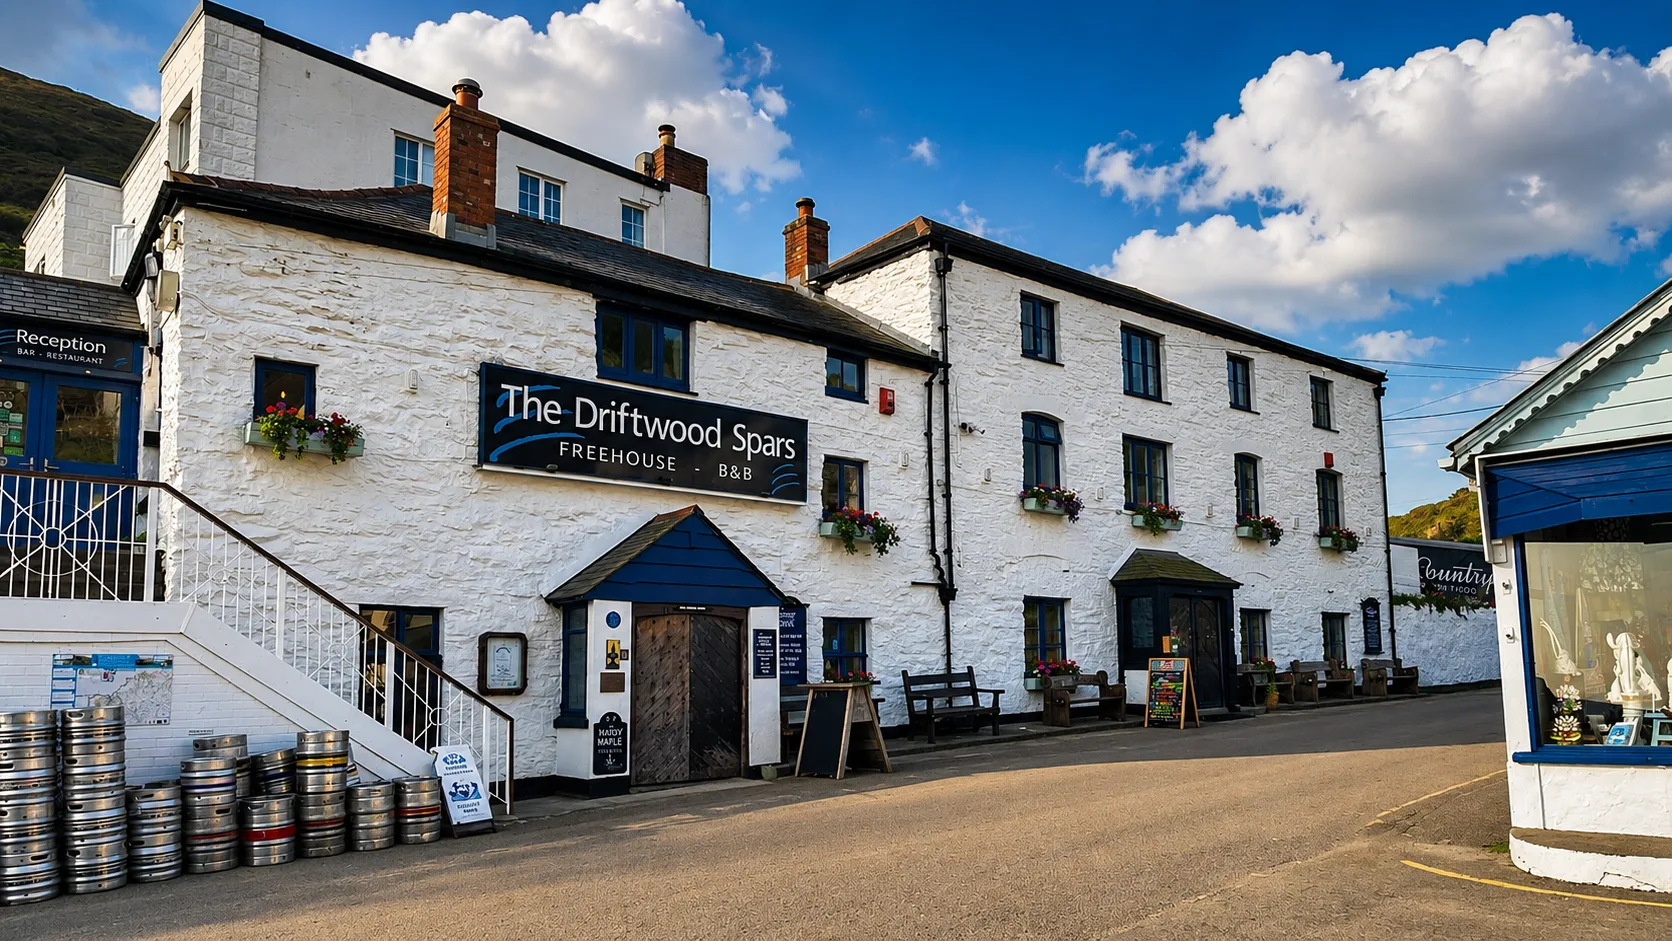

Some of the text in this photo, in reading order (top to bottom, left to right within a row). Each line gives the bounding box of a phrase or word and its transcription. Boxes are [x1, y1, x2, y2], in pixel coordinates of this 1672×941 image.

[16, 329, 107, 354] Reception
[17, 348, 36, 356] BAR
[46, 352, 104, 365] RESTAURANT
[500, 383, 796, 461] The Driftwood Spars
[559, 441, 676, 472] FREEHOUSE
[718, 463, 753, 481] B&B
